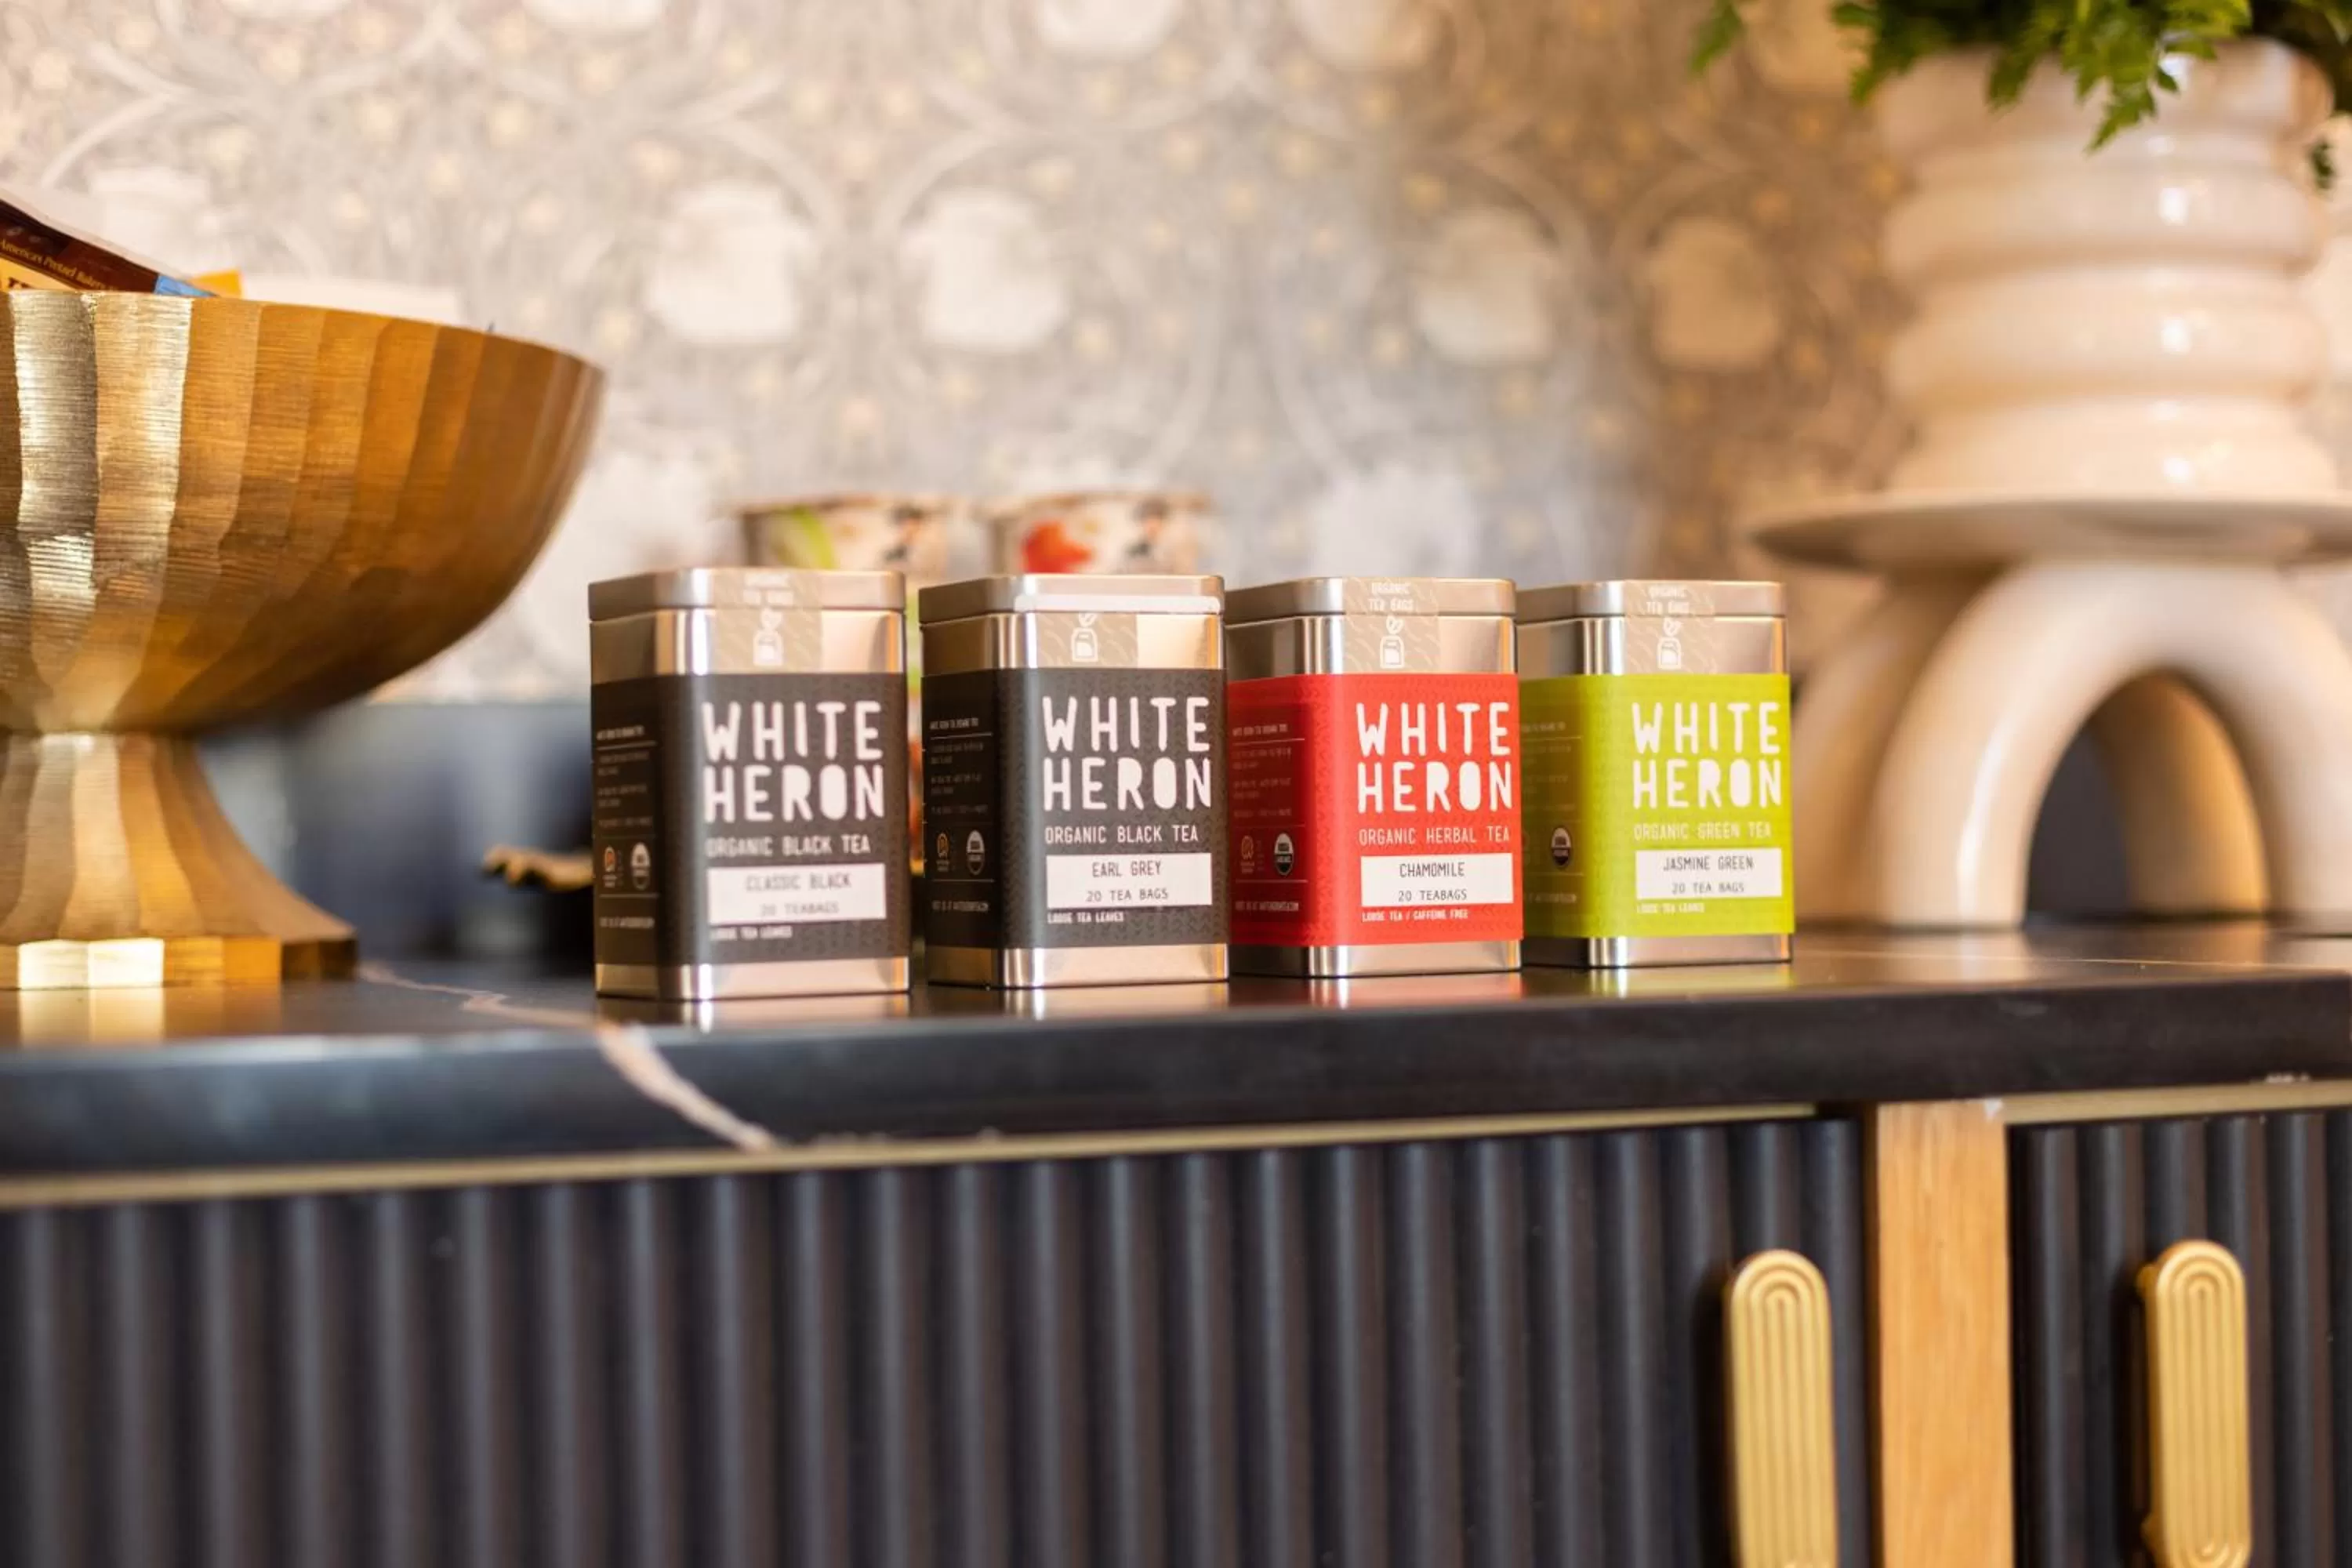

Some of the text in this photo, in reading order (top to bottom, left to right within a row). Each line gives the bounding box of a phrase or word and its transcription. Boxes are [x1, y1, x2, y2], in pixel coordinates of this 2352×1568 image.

[701, 700, 884, 762] WHITE
[1043, 696, 1210, 753] WHITE
[1356, 702, 1510, 757] WHITE
[1632, 702, 1780, 755] WHITE
[702, 765, 885, 822] HERON
[1044, 757, 1211, 811] HERON
[1357, 761, 1513, 814] HERON
[1632, 759, 1781, 809] HERON
[1045, 825, 1199, 844] ORGANIC BLACK TEA
[1359, 826, 1510, 846] ORGANIC HERBAL TEA
[1634, 822, 1771, 841] ORGANIC GREEN TEA
[706, 833, 871, 857] ORGANIC BLACK TEA
[1092, 860, 1161, 877] EARL GREY
[1399, 862, 1465, 878] CHAMOMILE
[1663, 855, 1754, 871] JASMINE GREEN
[746, 873, 851, 891] CLASSIC BLACK
[1671, 882, 1744, 895] 20 TEA BAGS
[1086, 887, 1169, 902] 20 TEA BAGS
[1398, 889, 1468, 902] 20 TEABAGS
[760, 901, 839, 916] 20 TEABAGS
[1047, 911, 1124, 924] LOOSE TEA LEAVES
[1362, 911, 1385, 923] LOOSE
[1389, 910, 1403, 922] TEA
[1413, 909, 1446, 921] CAFFEINE
[1450, 909, 1468, 920] FREE
